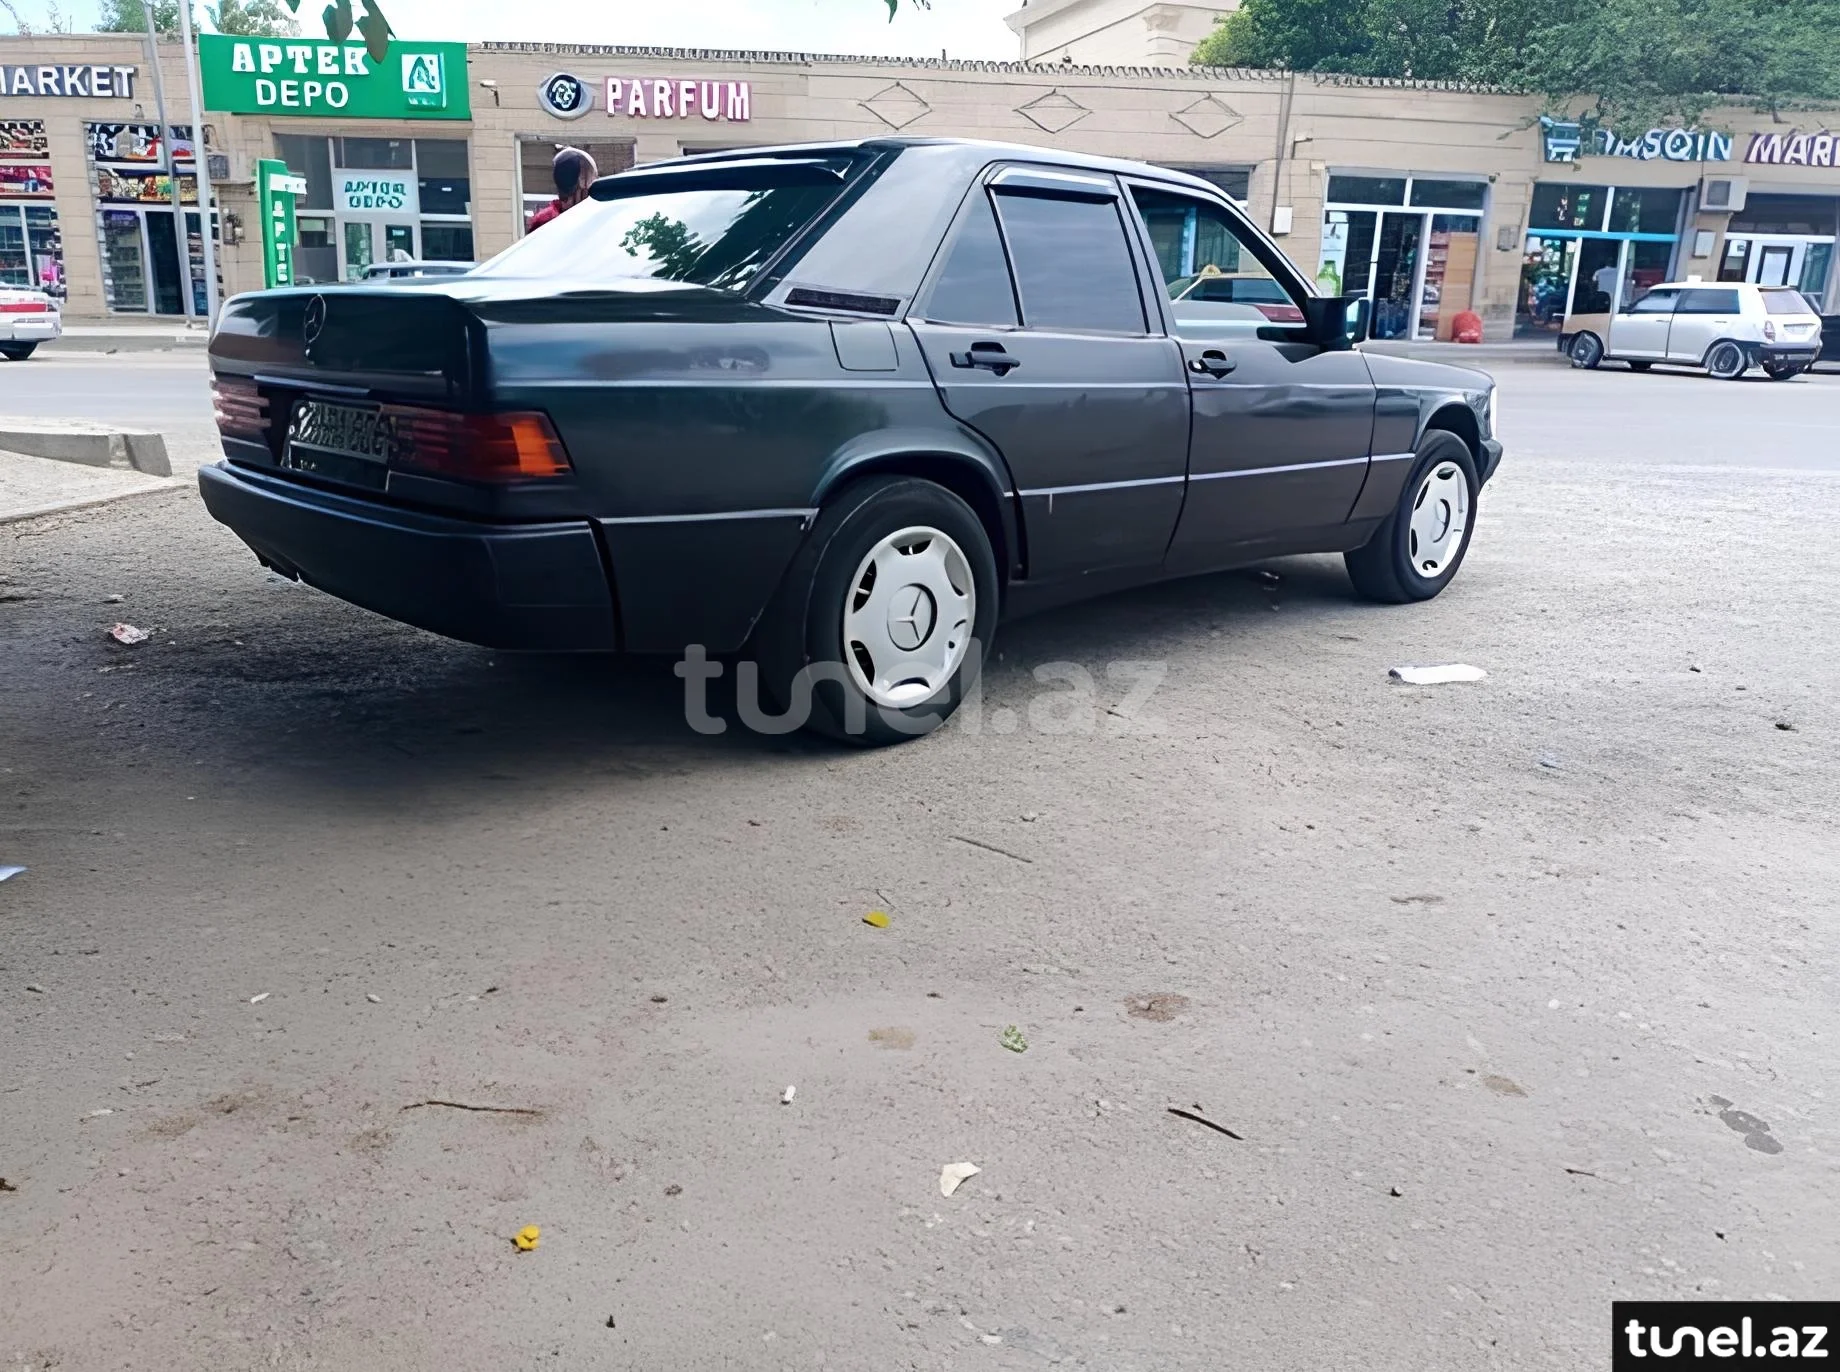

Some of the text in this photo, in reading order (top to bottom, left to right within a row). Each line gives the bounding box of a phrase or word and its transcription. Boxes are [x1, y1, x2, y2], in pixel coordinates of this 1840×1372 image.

[232, 43, 370, 75] APTEK
[255, 79, 349, 108] DEPO
[606, 77, 749, 121] PARFUM
